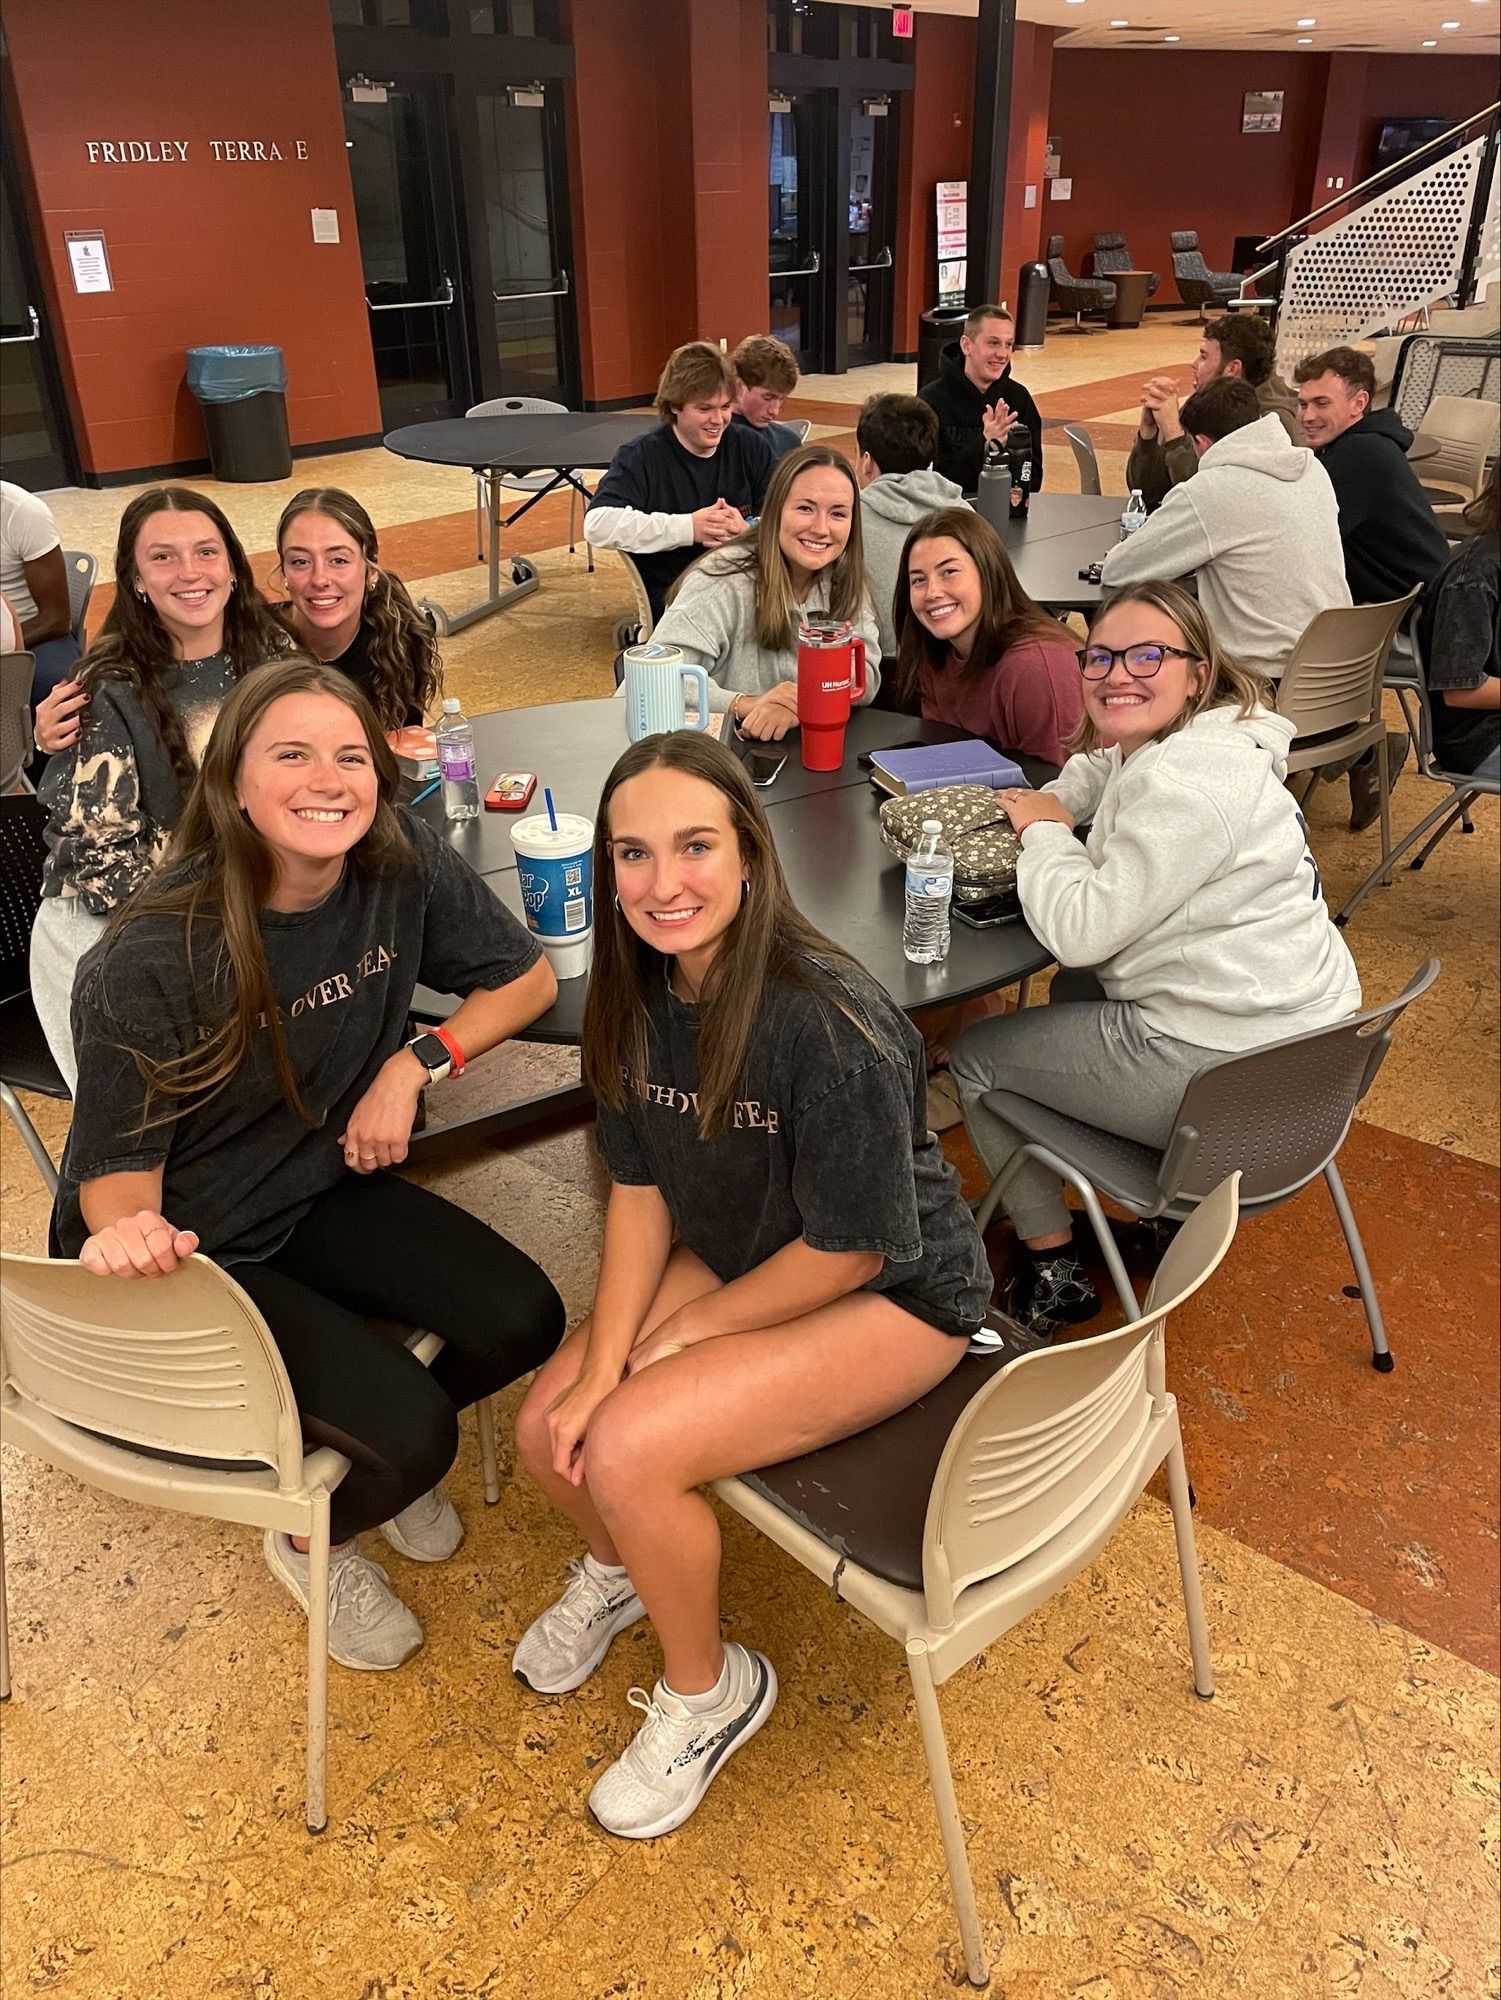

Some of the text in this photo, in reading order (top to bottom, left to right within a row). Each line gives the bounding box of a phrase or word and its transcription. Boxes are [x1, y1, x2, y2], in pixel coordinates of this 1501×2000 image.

[85, 140, 309, 163] FRIDLEY TERRAE
[567, 886, 582, 898] XL
[291, 972, 355, 1019] OVER
[732, 1100, 779, 1134] FER
